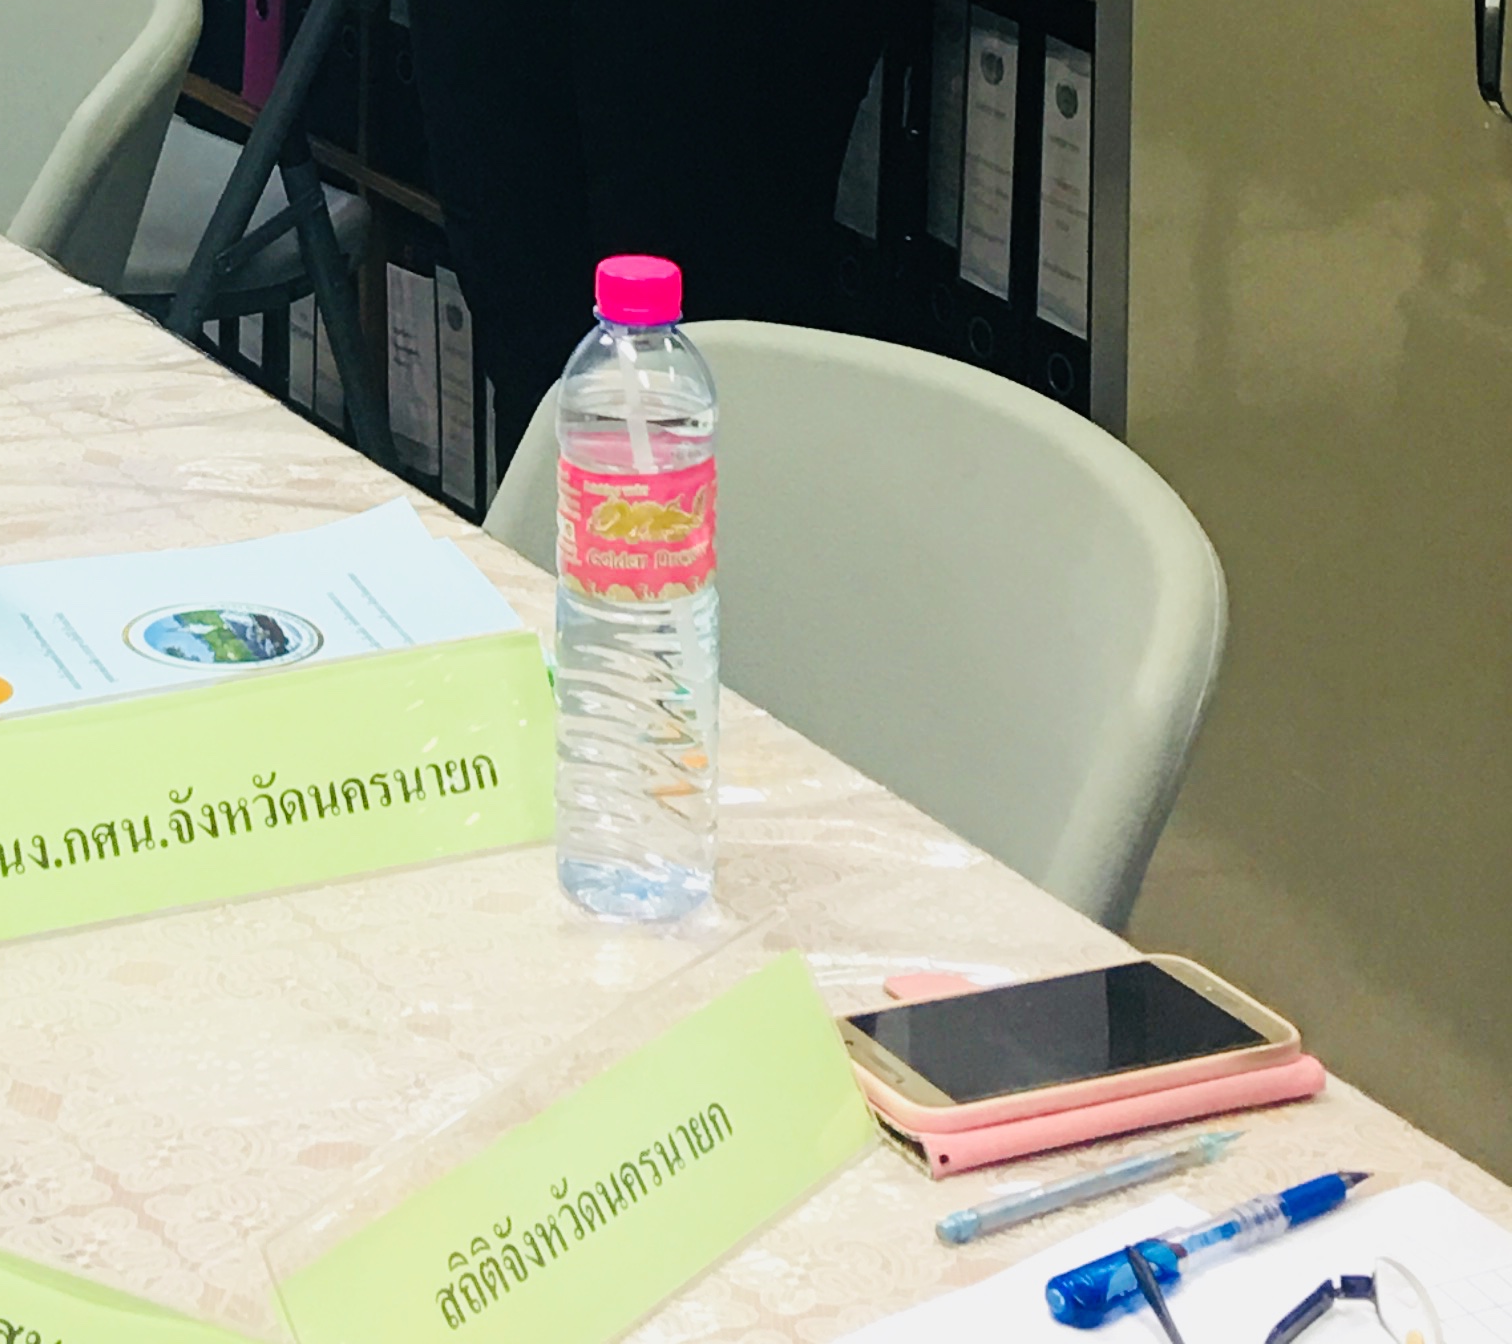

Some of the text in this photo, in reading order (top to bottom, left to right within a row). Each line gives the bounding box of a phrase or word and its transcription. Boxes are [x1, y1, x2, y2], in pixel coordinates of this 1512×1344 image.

[434, 1099, 735, 1332] สถิติจังหวัดนครนายก
